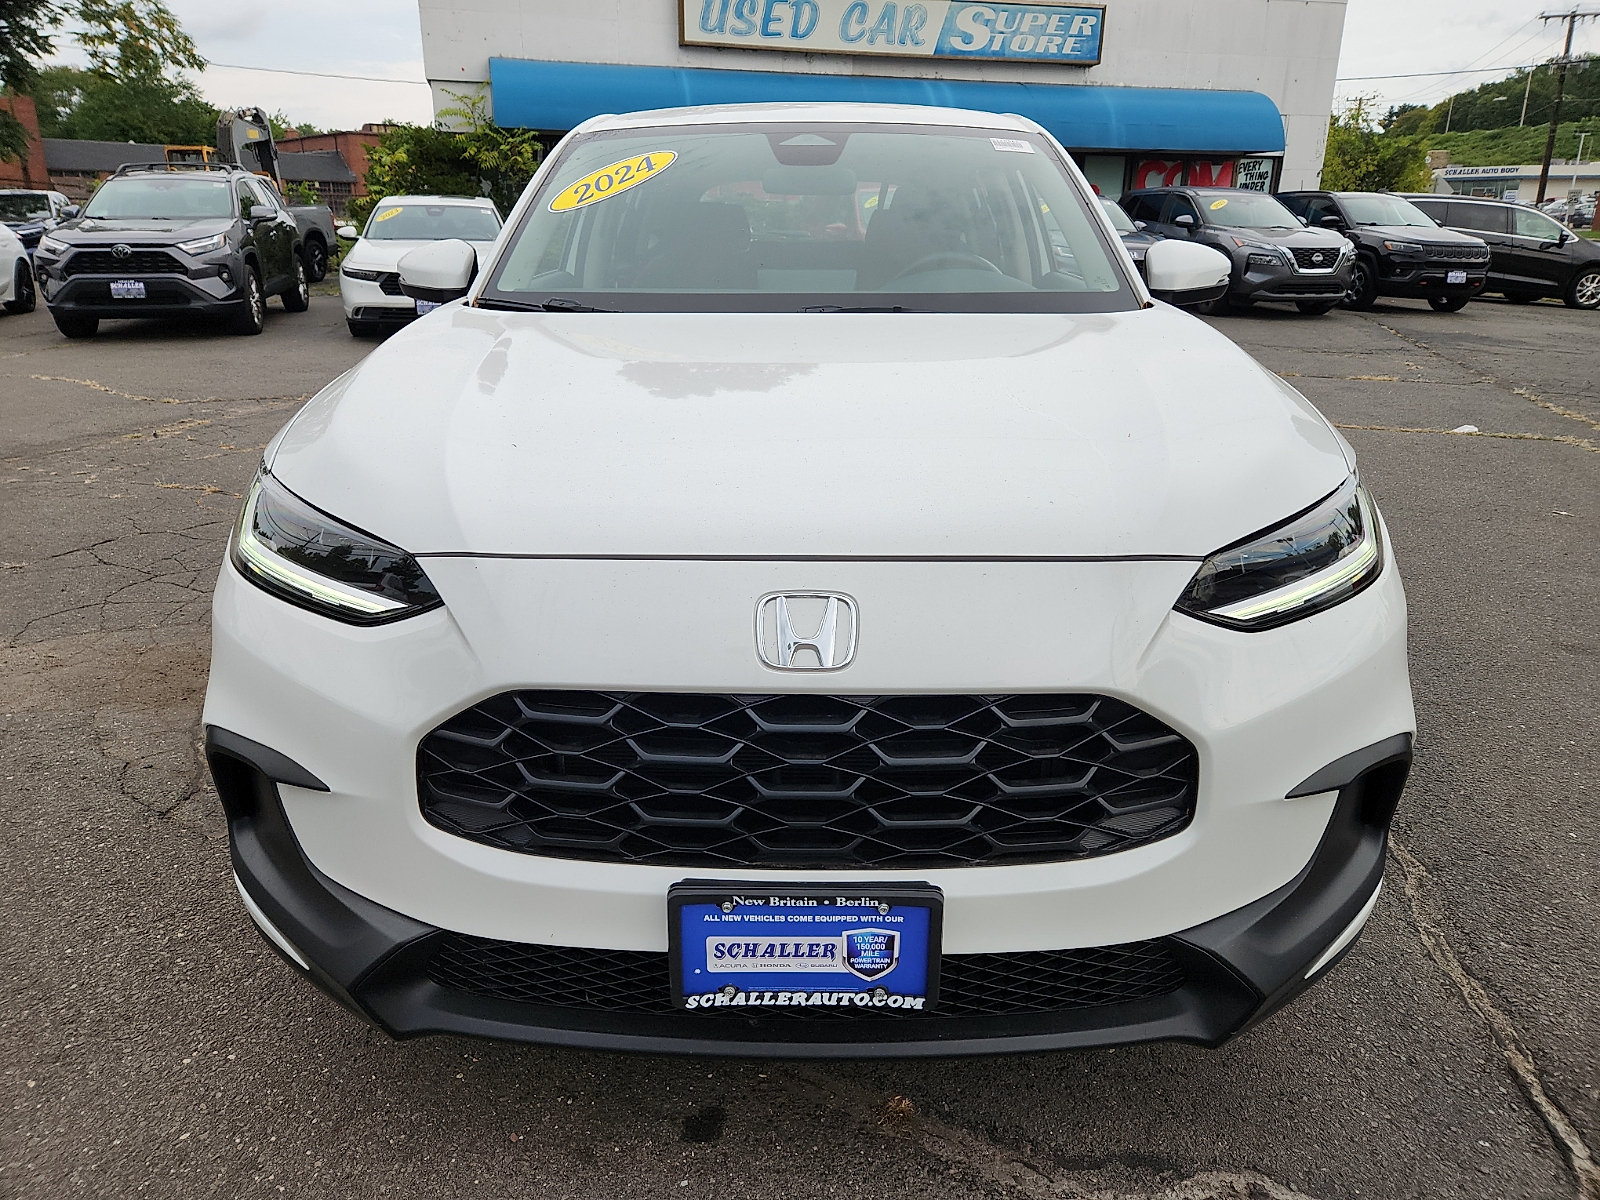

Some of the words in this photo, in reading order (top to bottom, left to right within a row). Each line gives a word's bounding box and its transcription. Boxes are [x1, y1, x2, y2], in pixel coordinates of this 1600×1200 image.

[699, 0, 820, 40] USED
[839, 0, 927, 46] CAR
[951, 5, 1097, 50] SUPER
[1238, 160, 1264, 174] EVERY
[1445, 168, 1480, 176] SCHALLER
[573, 156, 657, 204] 2024
[1244, 171, 1269, 181] THING
[1239, 181, 1266, 192] UNDER
[732, 896, 765, 906] New
[769, 896, 818, 907] Britain
[835, 897, 879, 907] Berlin
[713, 942, 838, 962] SCHALLER
[856, 943, 886, 951] 150,000
[685, 991, 925, 1010] SCHALLERAUTO.COM
